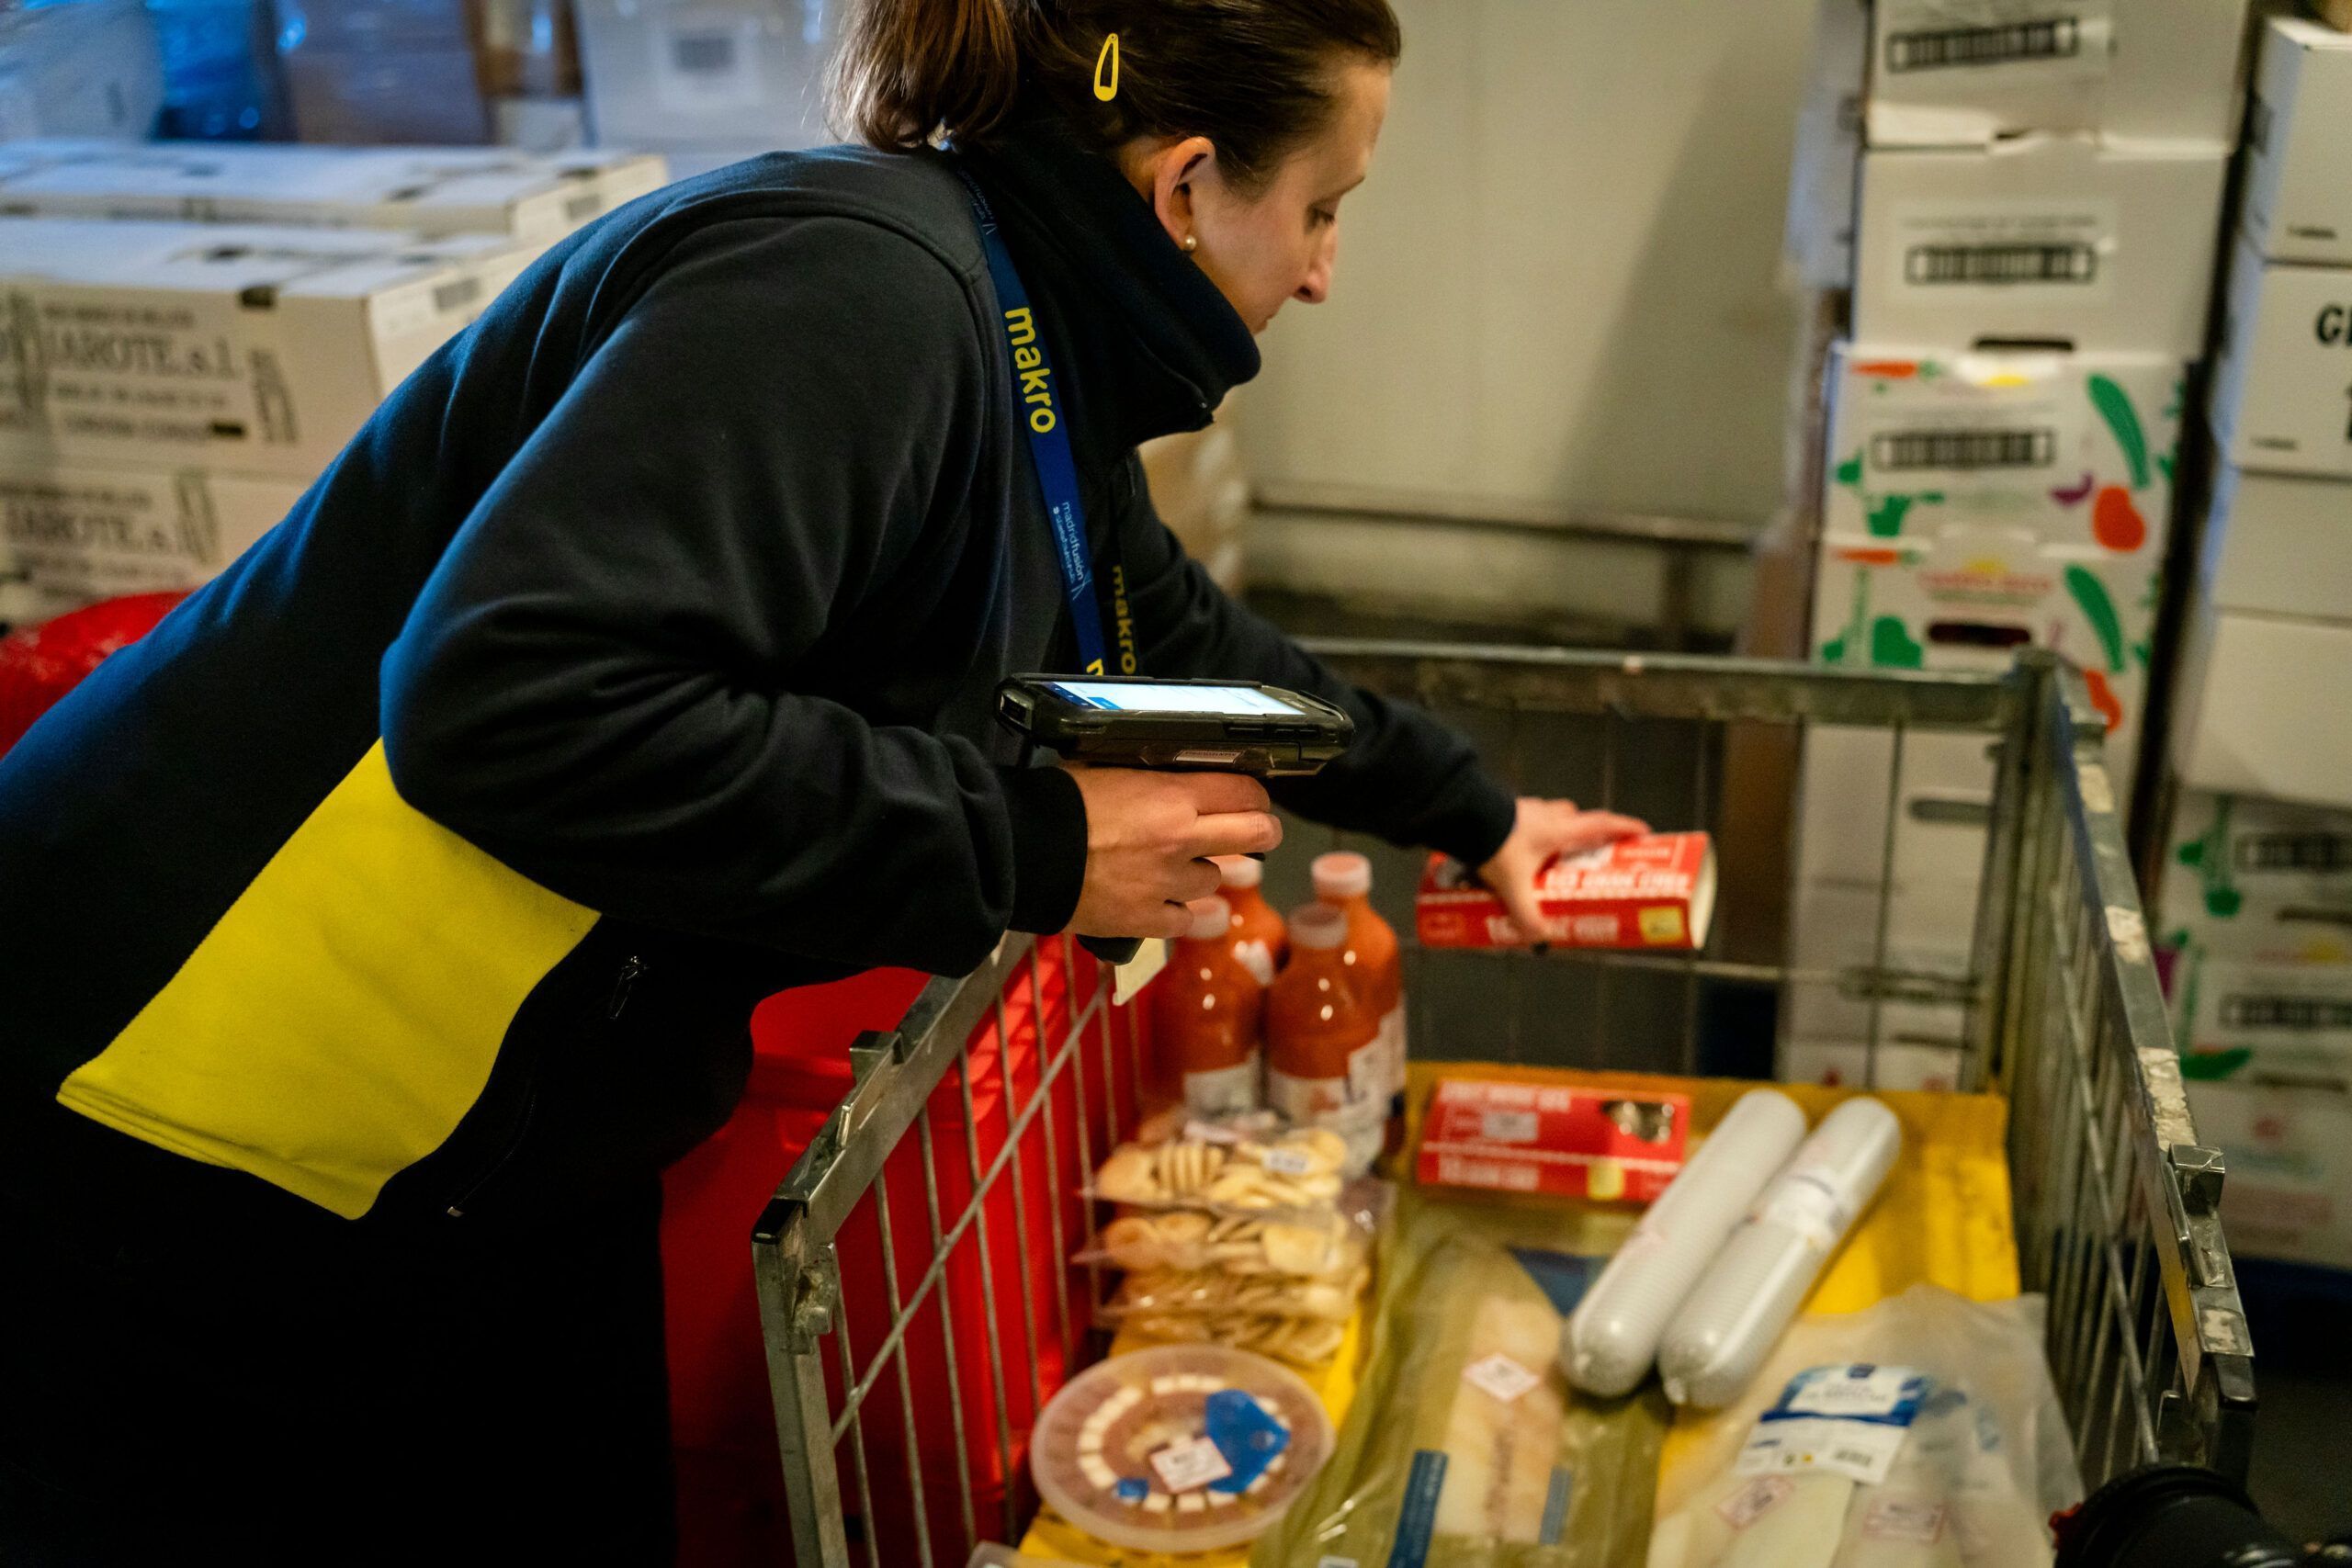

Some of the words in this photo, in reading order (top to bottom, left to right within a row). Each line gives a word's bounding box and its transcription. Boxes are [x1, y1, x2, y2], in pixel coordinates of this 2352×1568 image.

[1004, 307, 1057, 434] makro
[1061, 501, 1085, 581] madridfusión
[1112, 564, 1136, 675] makro
